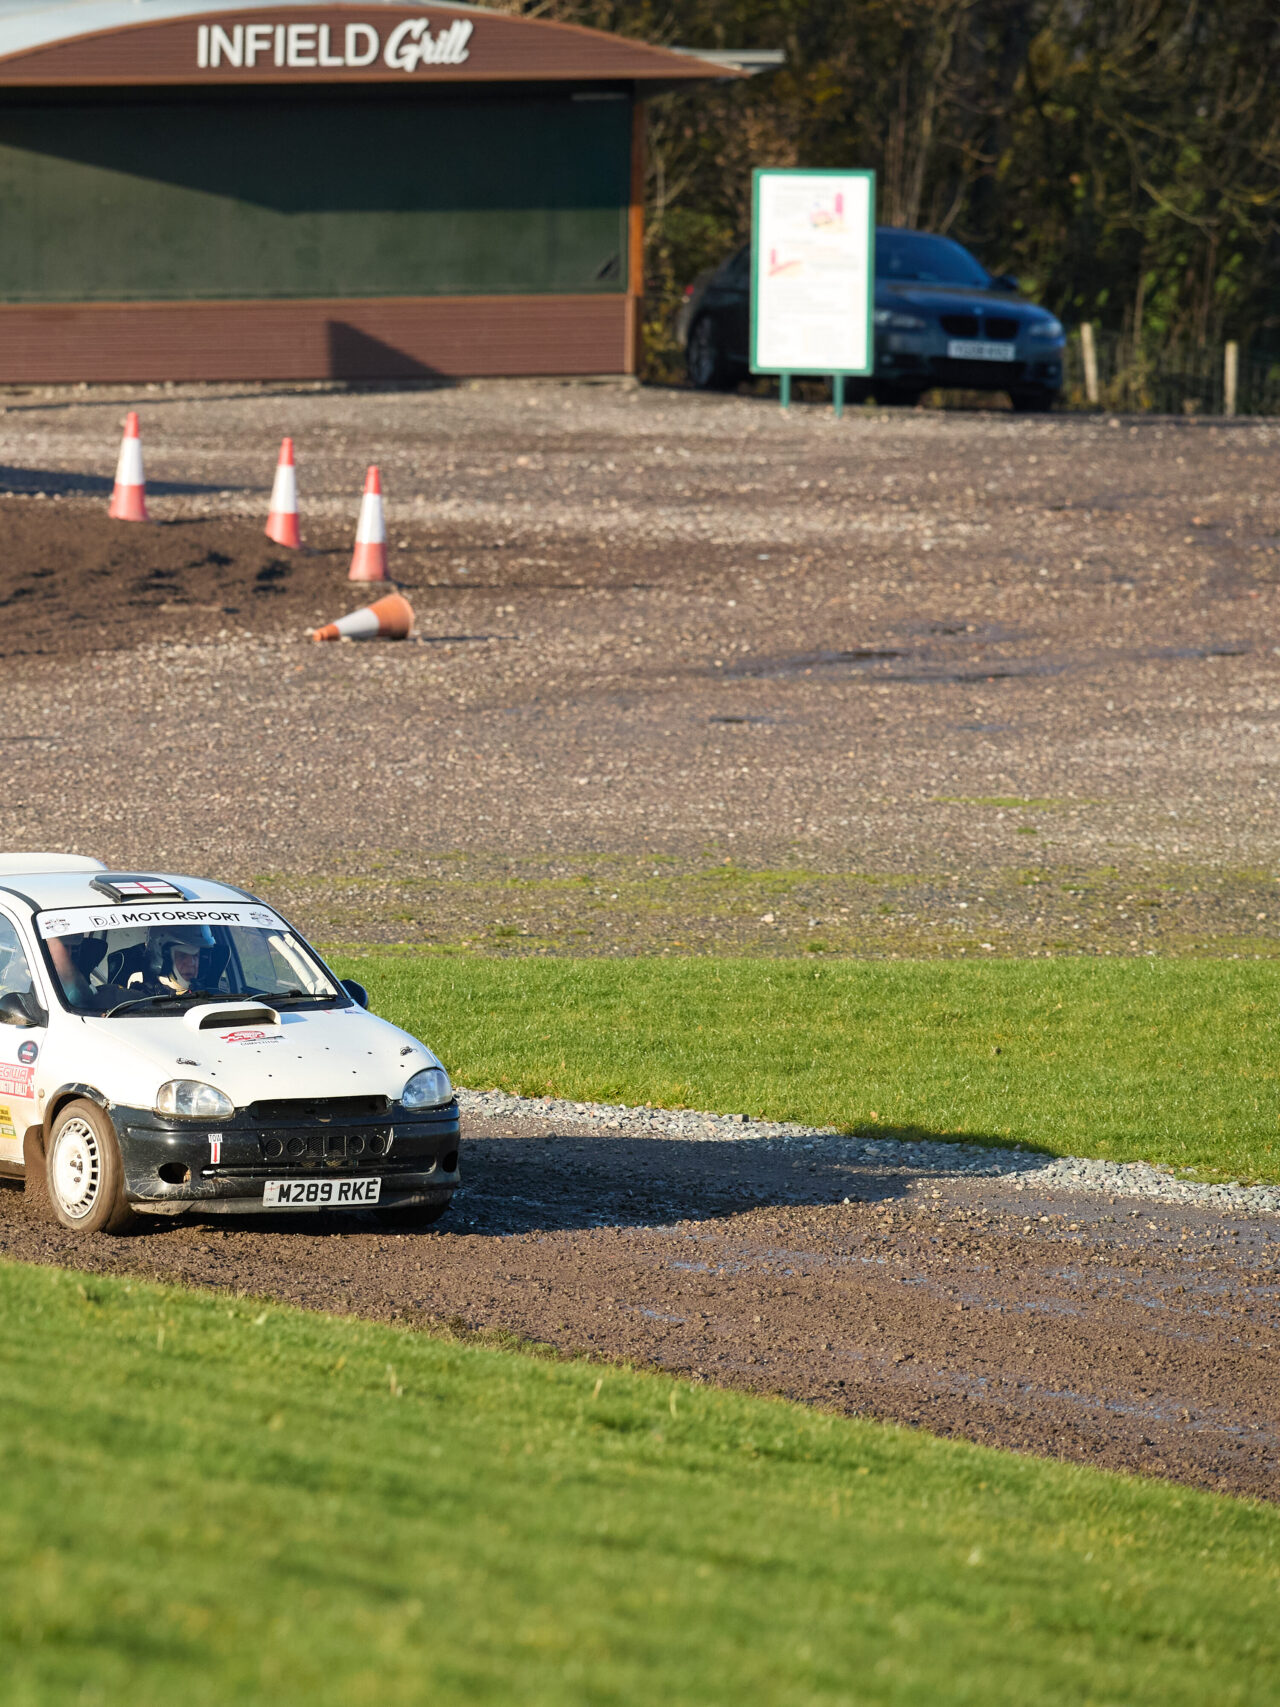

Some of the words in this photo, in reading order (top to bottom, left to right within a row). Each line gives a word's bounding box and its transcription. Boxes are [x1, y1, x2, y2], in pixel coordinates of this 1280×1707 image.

[197, 23, 380, 68] INFIELD
[383, 17, 474, 73] Grill
[88, 913, 120, 928] DJ
[122, 911, 241, 923] MOTORSPORT
[208, 1133, 222, 1143] TOW
[277, 1183, 333, 1203] M289
[338, 1180, 379, 1200] RKE
